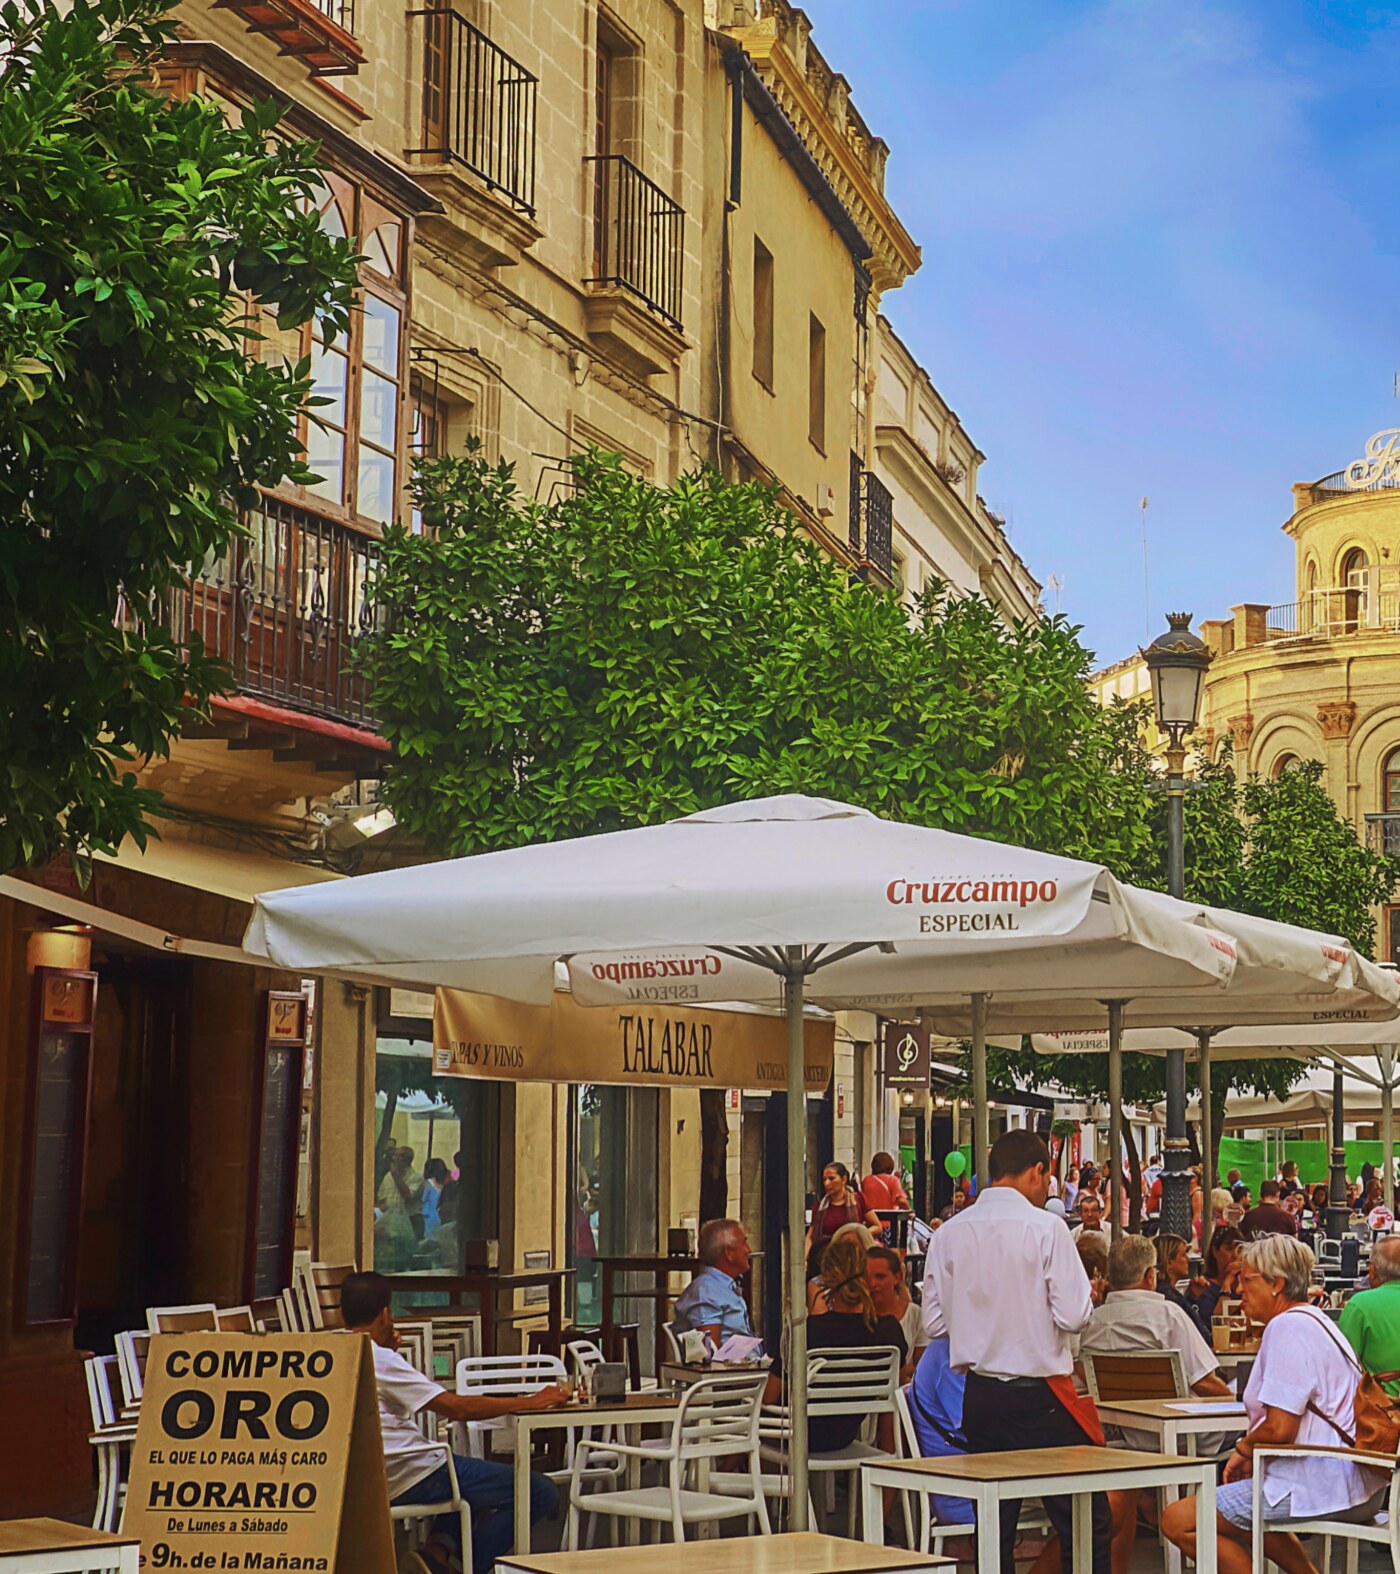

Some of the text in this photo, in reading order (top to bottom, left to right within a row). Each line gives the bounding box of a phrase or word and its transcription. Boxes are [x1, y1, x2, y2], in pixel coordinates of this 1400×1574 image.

[886, 878, 1058, 908] Cruzcampo
[919, 913, 1019, 933] ESPECIAL
[1313, 1009, 1370, 1020] ESPECIAL
[482, 1043, 492, 1065] Y
[493, 1044, 524, 1068] VINOS
[618, 1014, 714, 1078] TALABAR
[165, 1349, 334, 1379] COMPRO
[161, 1389, 330, 1441] ORO
[149, 1448, 328, 1466] EL QUE LO PAGA MÁS CARO
[149, 1481, 317, 1509] HORARIO
[167, 1517, 289, 1532] De Lunes a Sábado
[220, 1551, 240, 1570] la
[244, 1553, 328, 1571] Mañana
